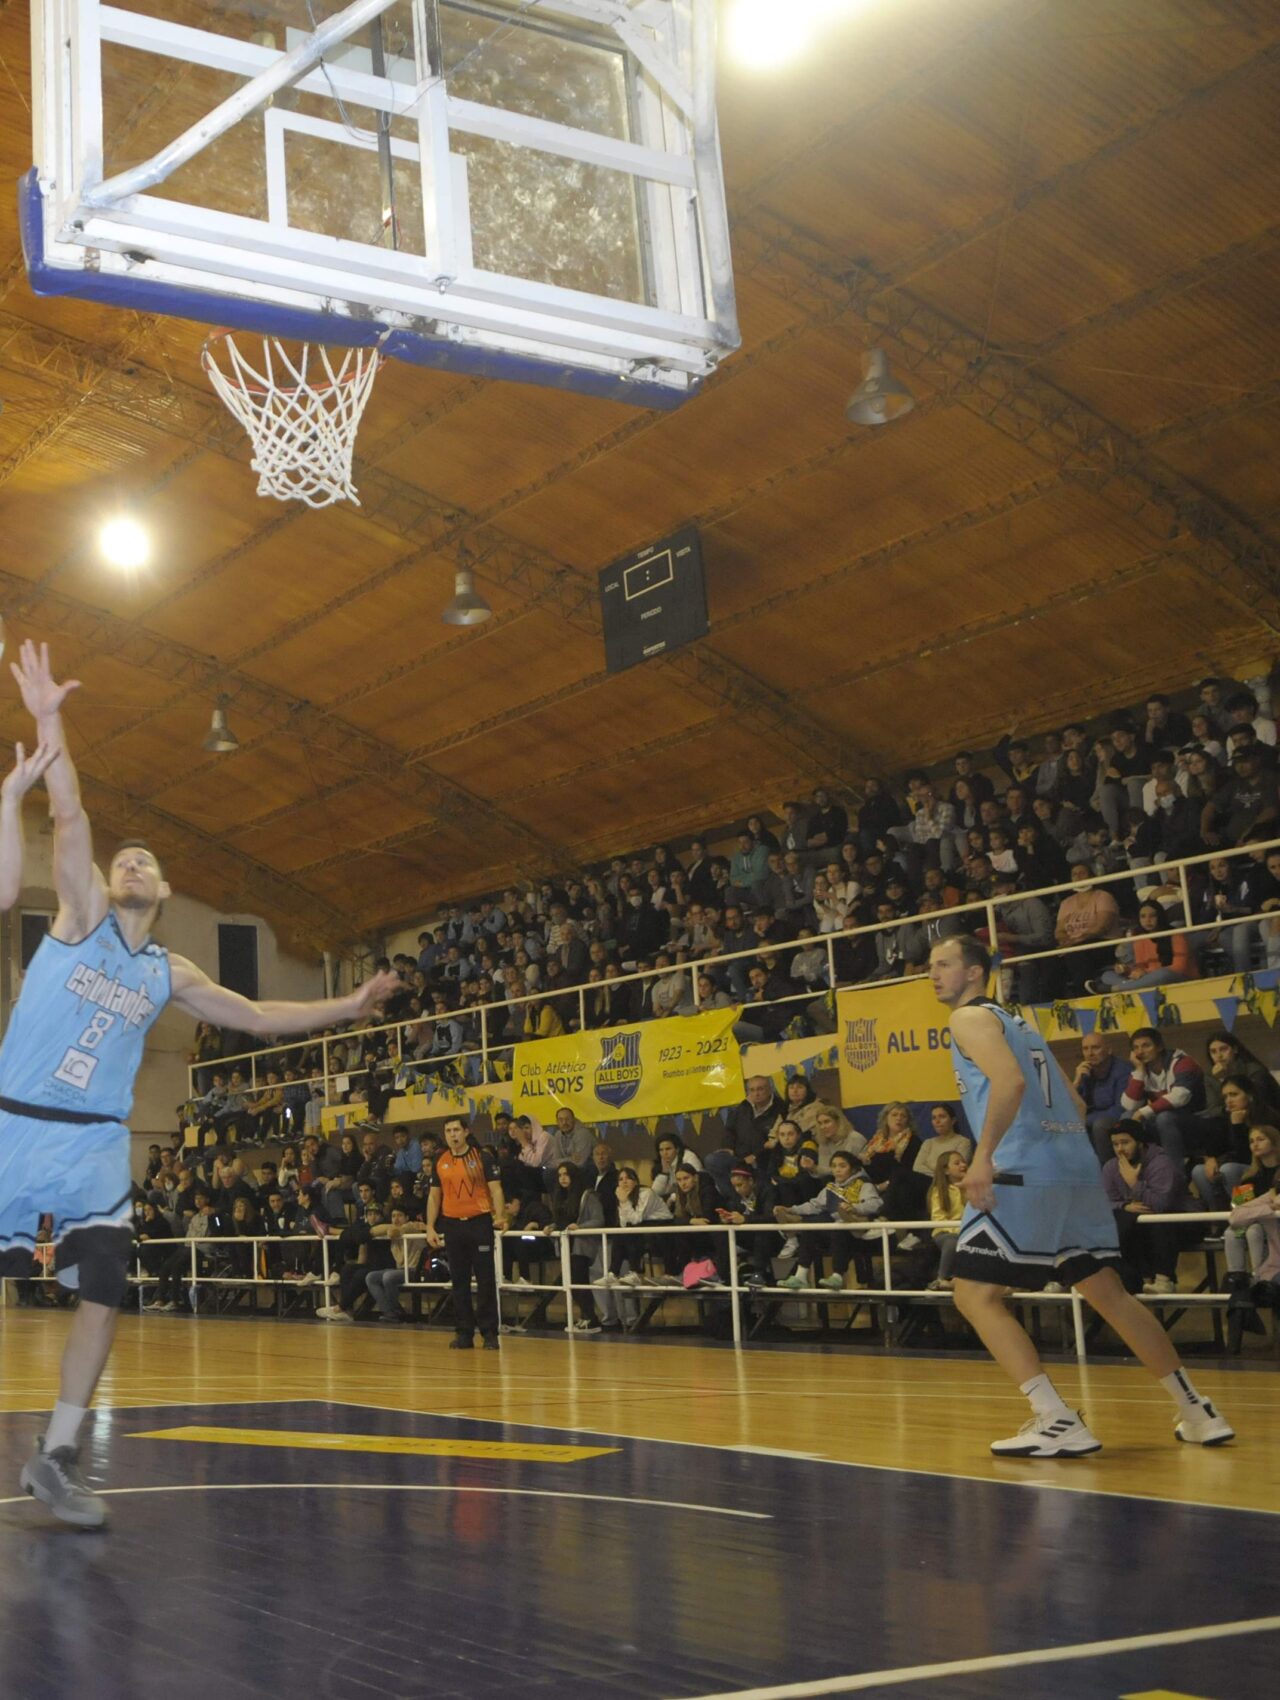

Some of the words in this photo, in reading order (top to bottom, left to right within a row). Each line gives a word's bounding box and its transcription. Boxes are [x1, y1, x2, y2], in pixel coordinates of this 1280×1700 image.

[77, 1008, 117, 1050] 8
[887, 1029, 920, 1054] ALL
[927, 1027, 952, 1050] BO
[658, 1045, 683, 1063] 1923
[696, 1037, 729, 1056] 2023
[520, 1064, 541, 1078] Club
[598, 1070, 616, 1083] ALL
[616, 1067, 639, 1081] BOYS
[520, 1079, 545, 1098] ALL
[547, 1075, 584, 1095] BOYS
